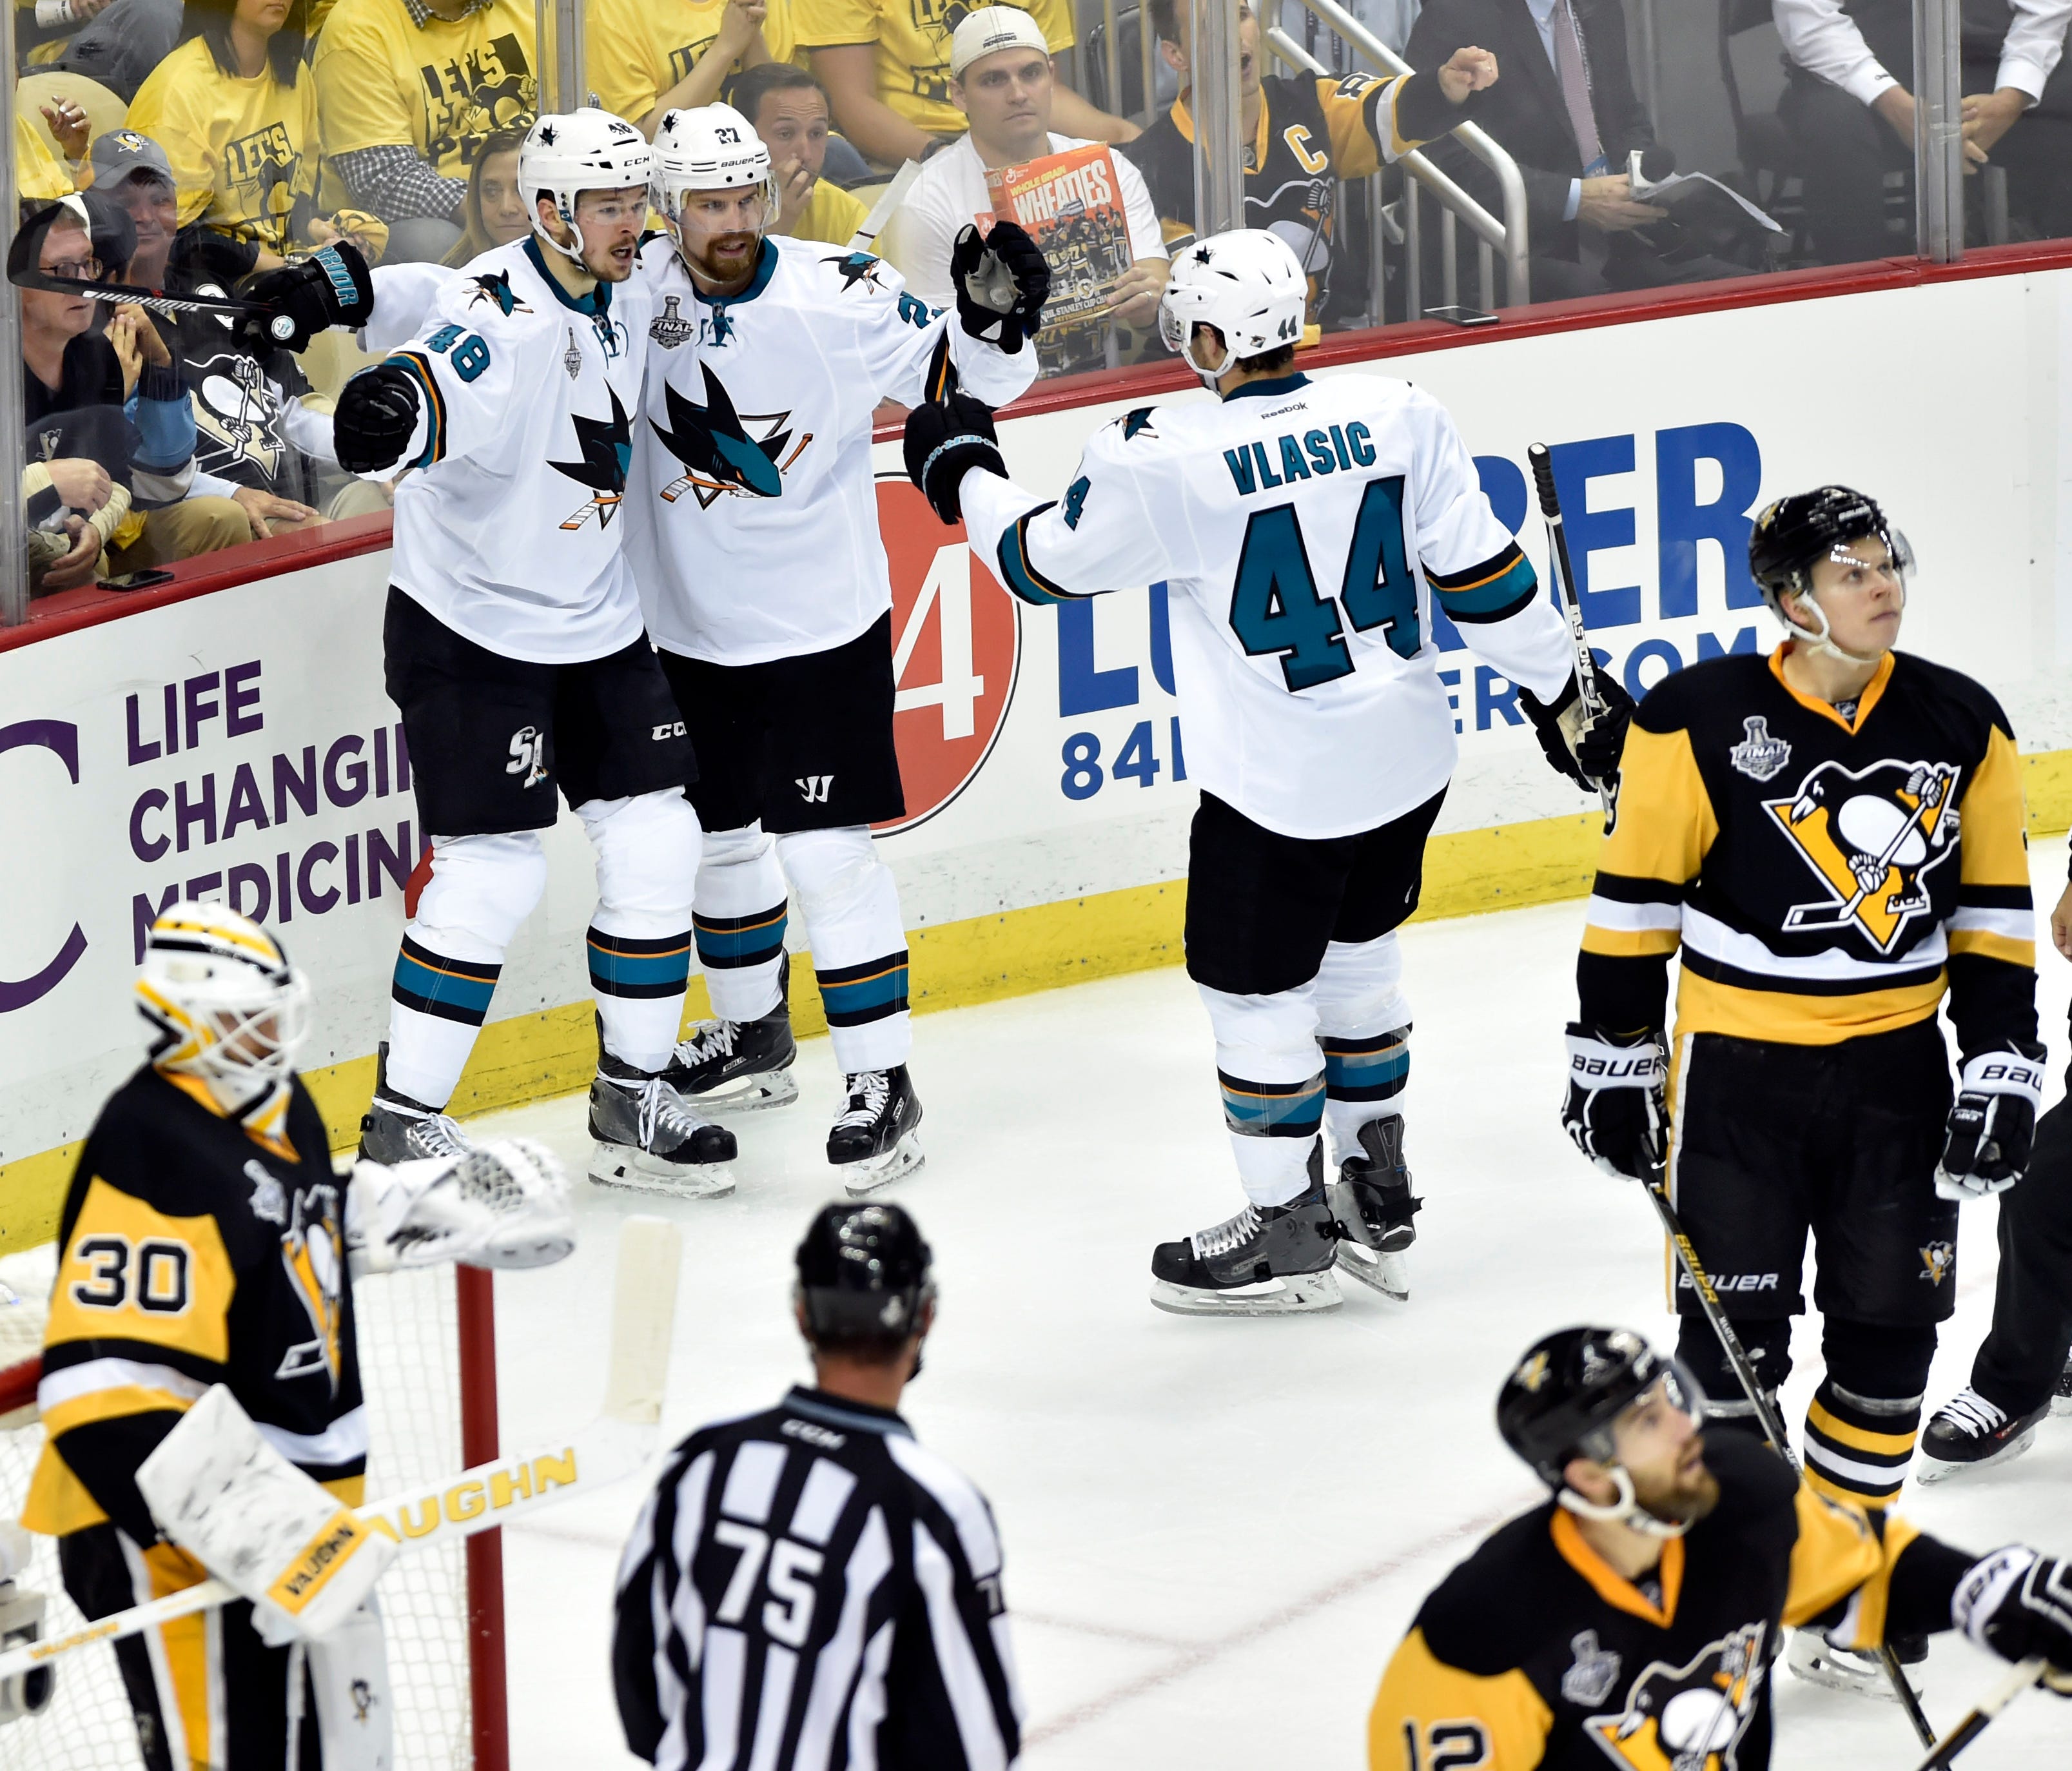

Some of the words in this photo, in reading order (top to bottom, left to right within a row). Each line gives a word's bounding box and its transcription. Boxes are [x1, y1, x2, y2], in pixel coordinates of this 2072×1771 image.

[714, 127, 741, 144] 27
[1283, 124, 1328, 175] C
[623, 155, 650, 167] CCM
[721, 157, 754, 168] BAUER
[1010, 177, 1041, 197] WHOLE
[1041, 164, 1067, 182] GRAIN
[1013, 159, 1113, 226] WHEATIES
[1055, 301, 1084, 317] STANLEY
[650, 322, 694, 333] FINAL
[1277, 315, 1297, 340] 44
[423, 324, 491, 384] 48
[1261, 402, 1308, 420] Reebok
[1222, 421, 1377, 496] VLASIC
[1228, 475, 1423, 693] 44
[126, 660, 263, 767] LIFE
[652, 721, 687, 741] CC
[129, 722, 411, 863] CHANGI
[1572, 1053, 1661, 1077] BAUER
[1980, 1064, 2042, 1092] BAU
[72, 1235, 192, 1315] 30
[361, 1447, 578, 1546] AUGHN
[714, 1520, 825, 1649] 75
